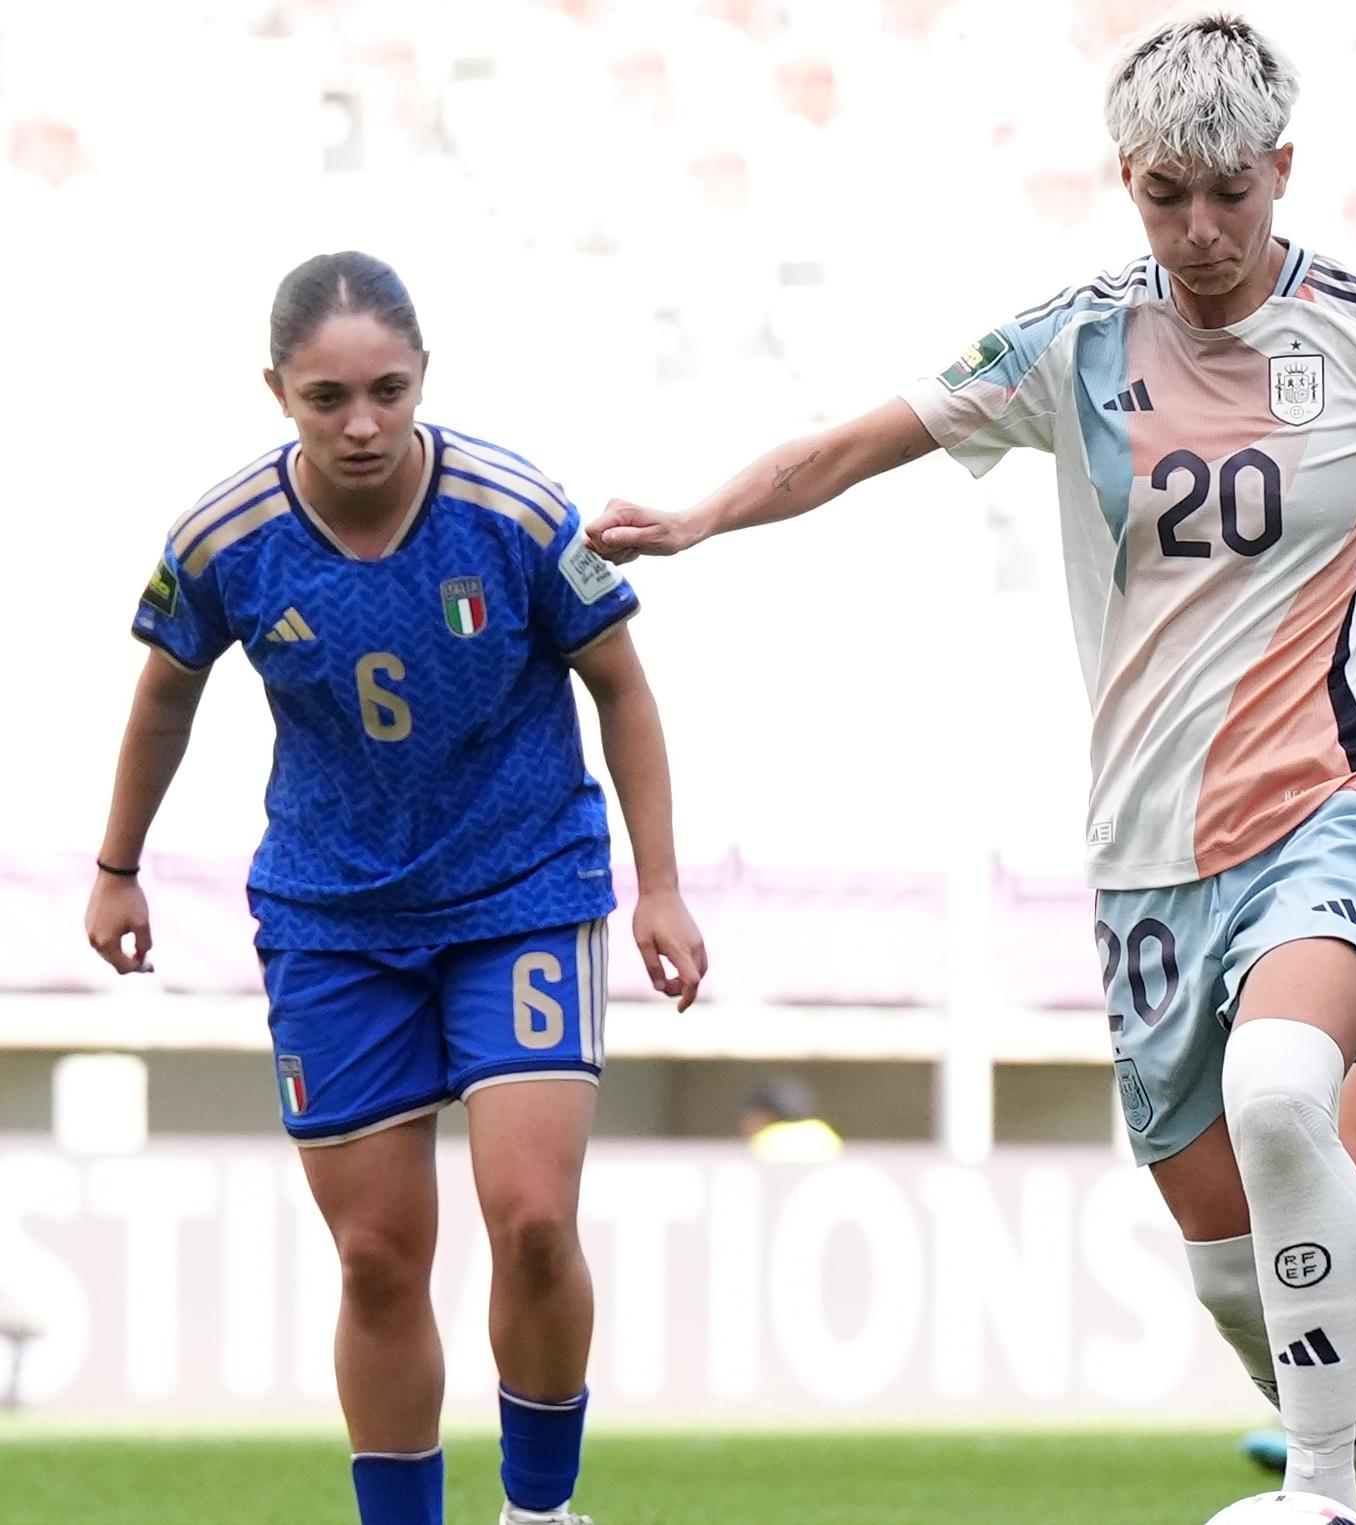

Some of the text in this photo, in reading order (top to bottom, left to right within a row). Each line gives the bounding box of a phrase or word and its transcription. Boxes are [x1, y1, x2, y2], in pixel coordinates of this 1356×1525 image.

[1151, 447, 1283, 559] 20
[355, 651, 412, 743] 6
[512, 951, 564, 1050] 6
